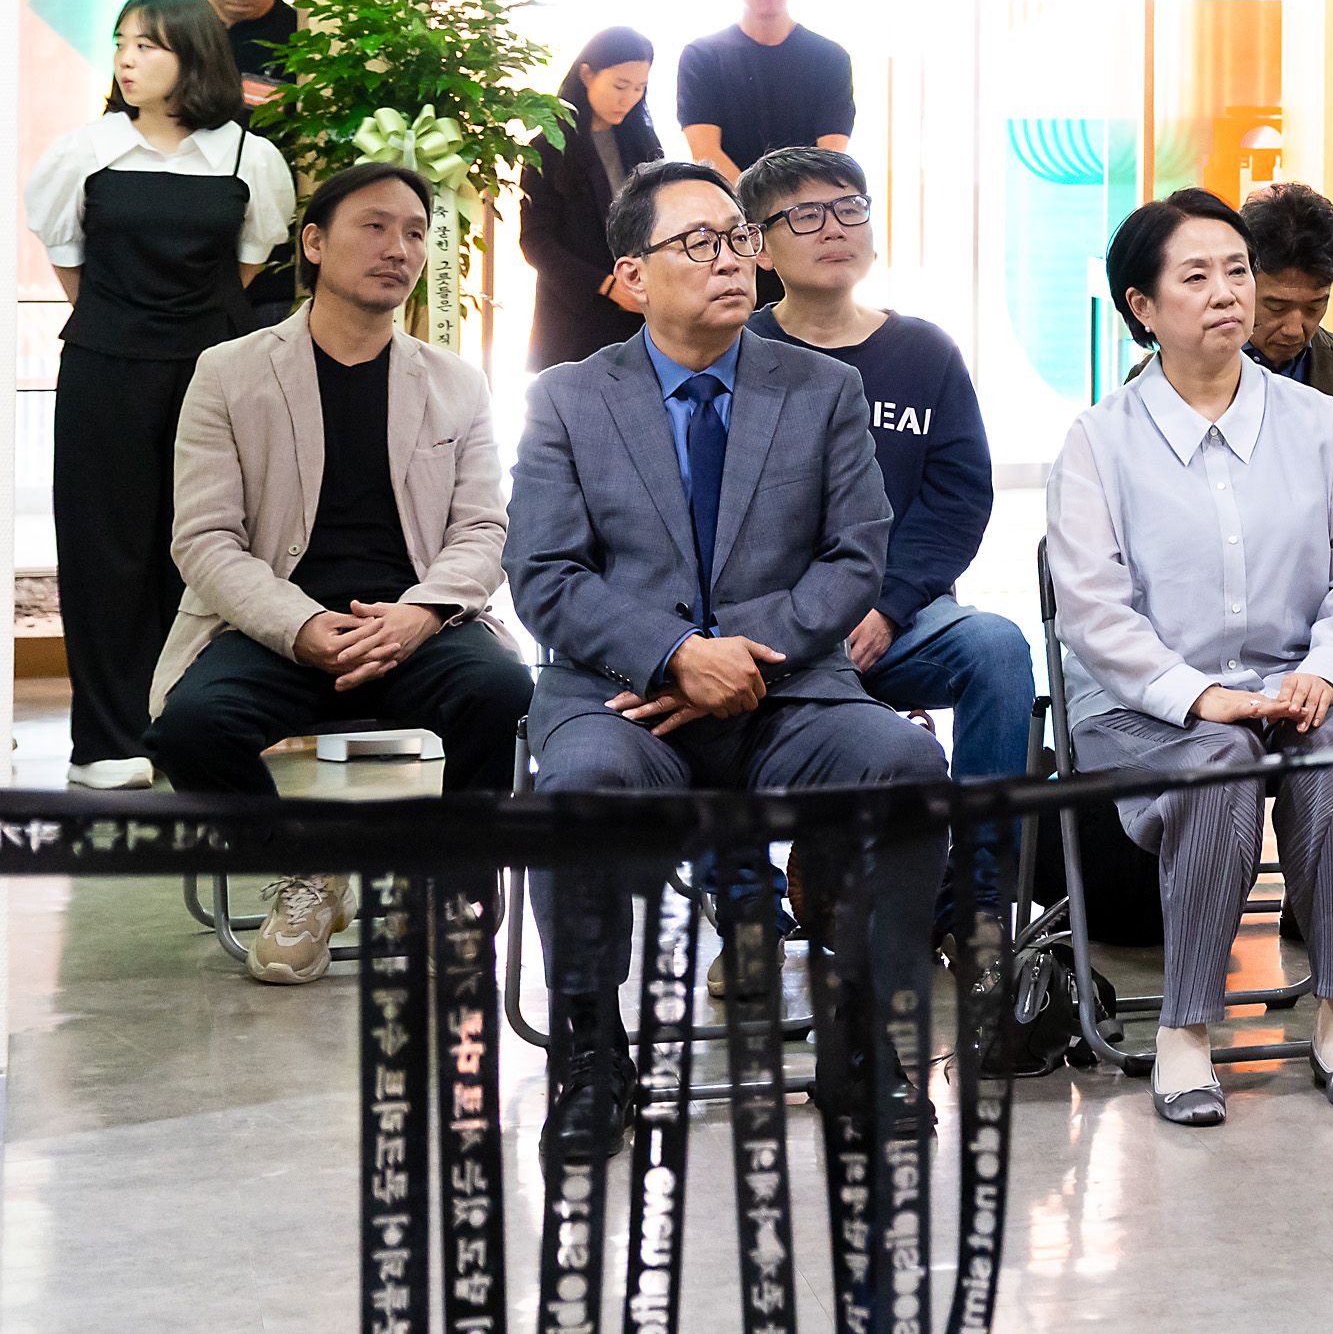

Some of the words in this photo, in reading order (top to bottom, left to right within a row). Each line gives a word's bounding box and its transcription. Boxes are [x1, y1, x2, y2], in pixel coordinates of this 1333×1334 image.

[433, 205, 449, 218] 축
[435, 260, 453, 313] 그릇들은
[437, 320, 455, 346] 아직
